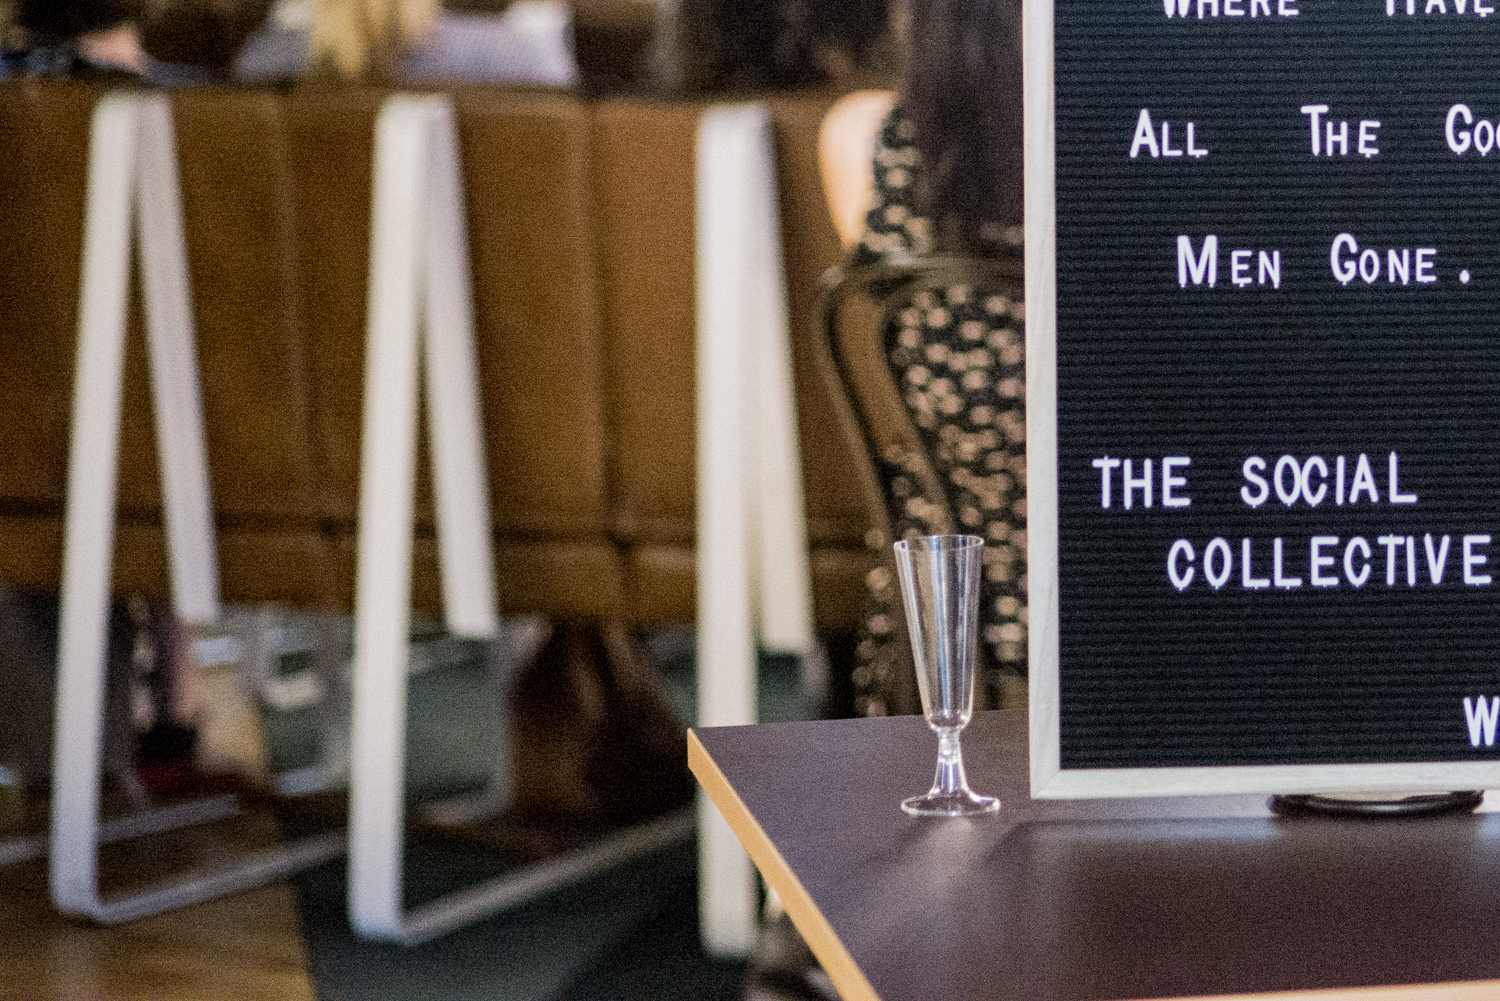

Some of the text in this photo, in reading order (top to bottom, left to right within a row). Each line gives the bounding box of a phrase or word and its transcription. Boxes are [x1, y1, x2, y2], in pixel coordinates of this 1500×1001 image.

[1128, 107, 1209, 159] ALL
[1299, 104, 1382, 159] THE
[1176, 234, 1282, 290] MEN
[1091, 451, 1418, 510] THE SOCIAL
[1166, 532, 1493, 592] COLLECTIVE
